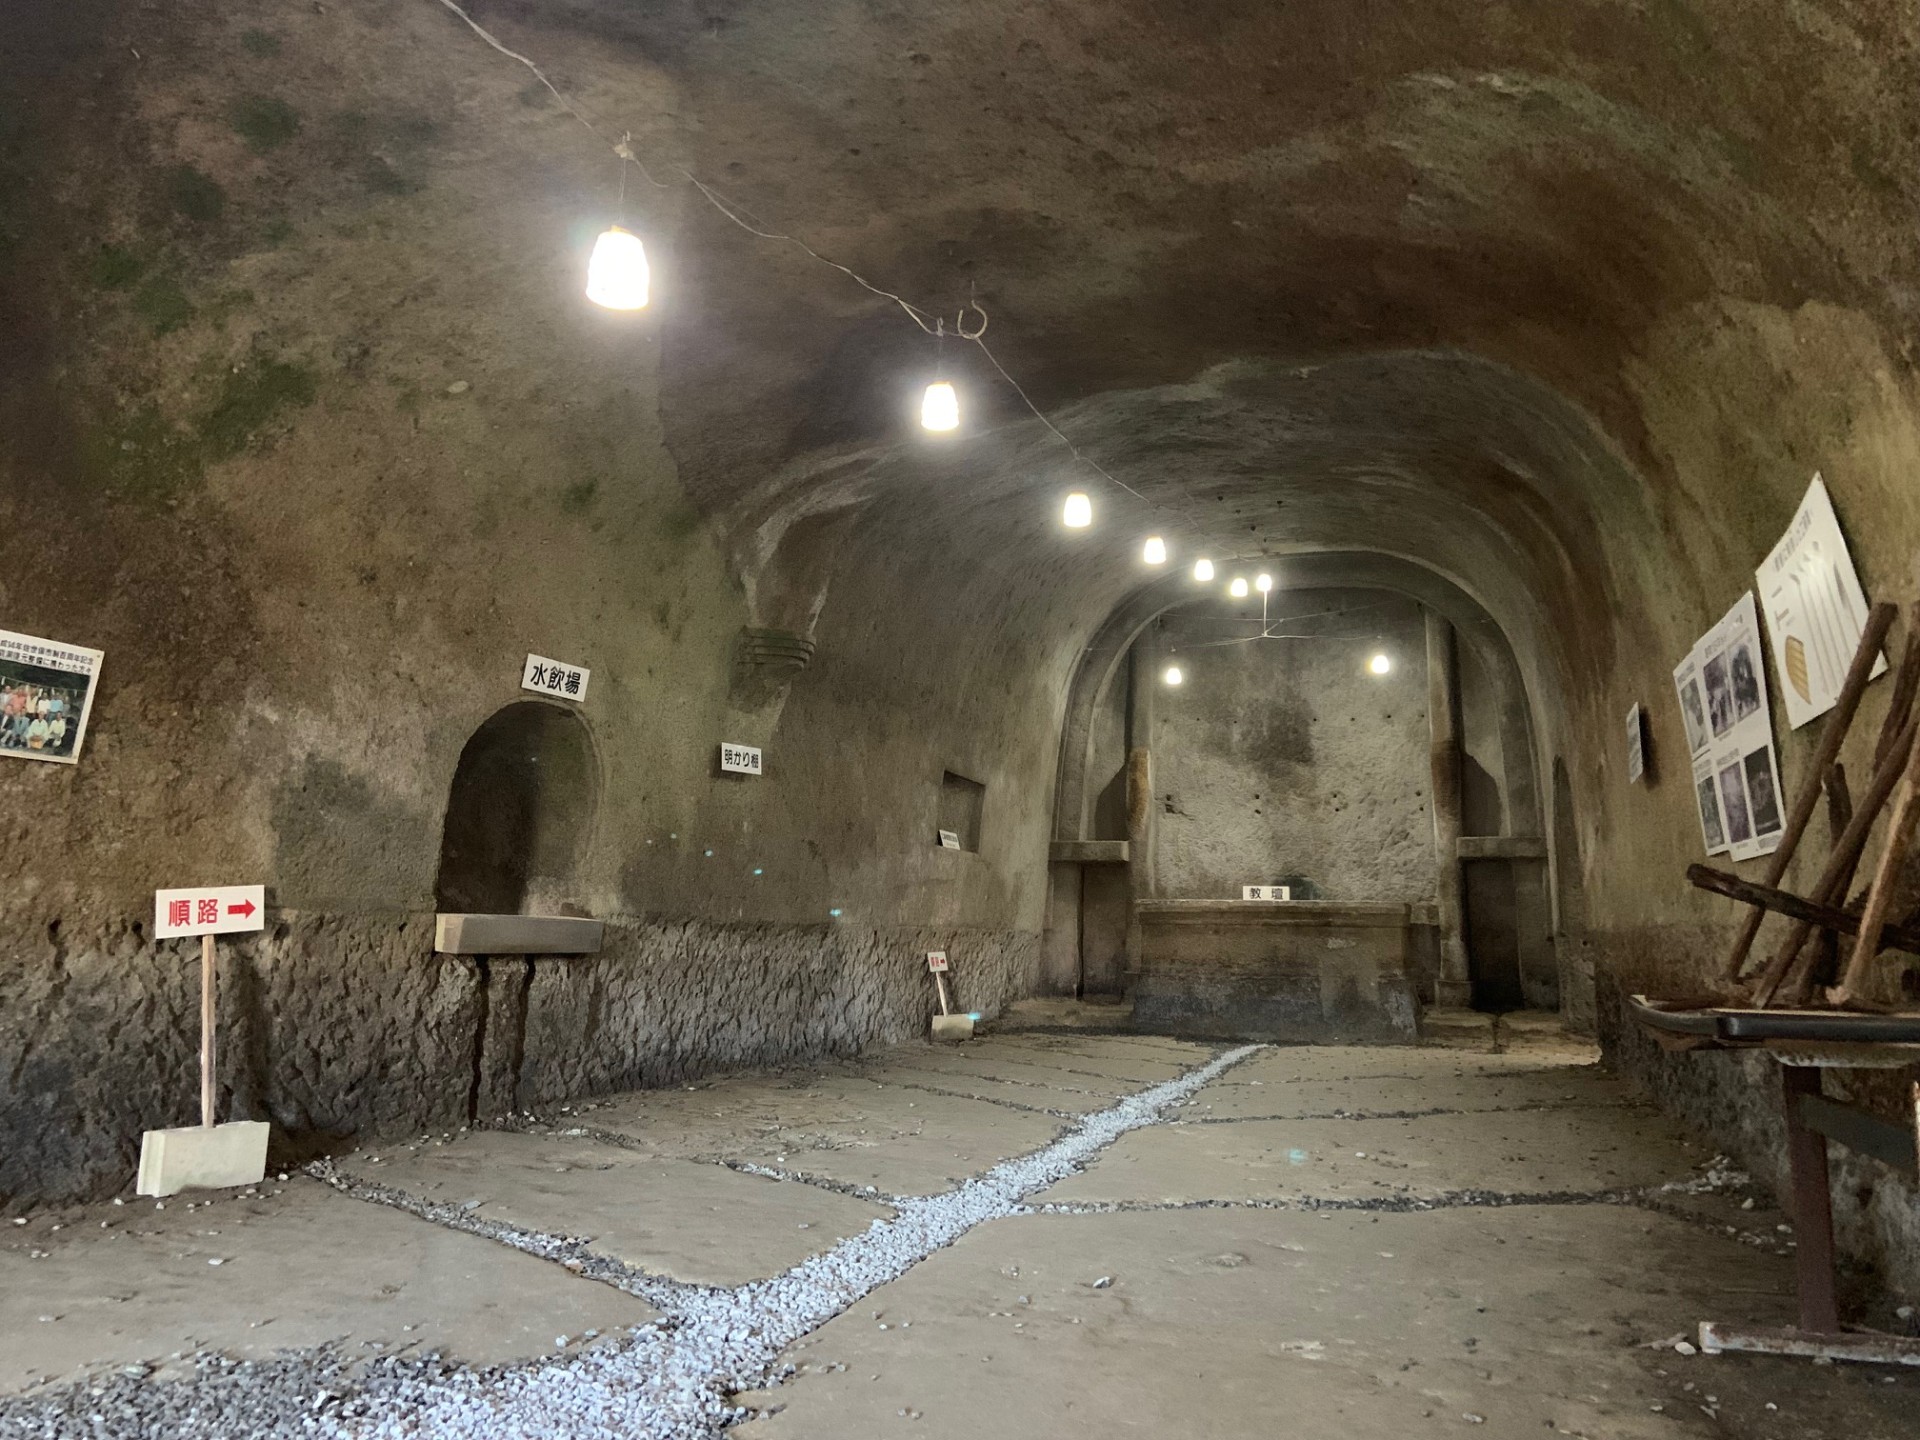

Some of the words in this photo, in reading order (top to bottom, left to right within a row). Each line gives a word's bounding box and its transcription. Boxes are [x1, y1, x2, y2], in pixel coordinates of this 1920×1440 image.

[530, 663, 581, 695] 水飲場
[725, 748, 759, 768] 明かり棚
[1250, 887, 1283, 899] 教壇
[168, 899, 218, 927] 順路
